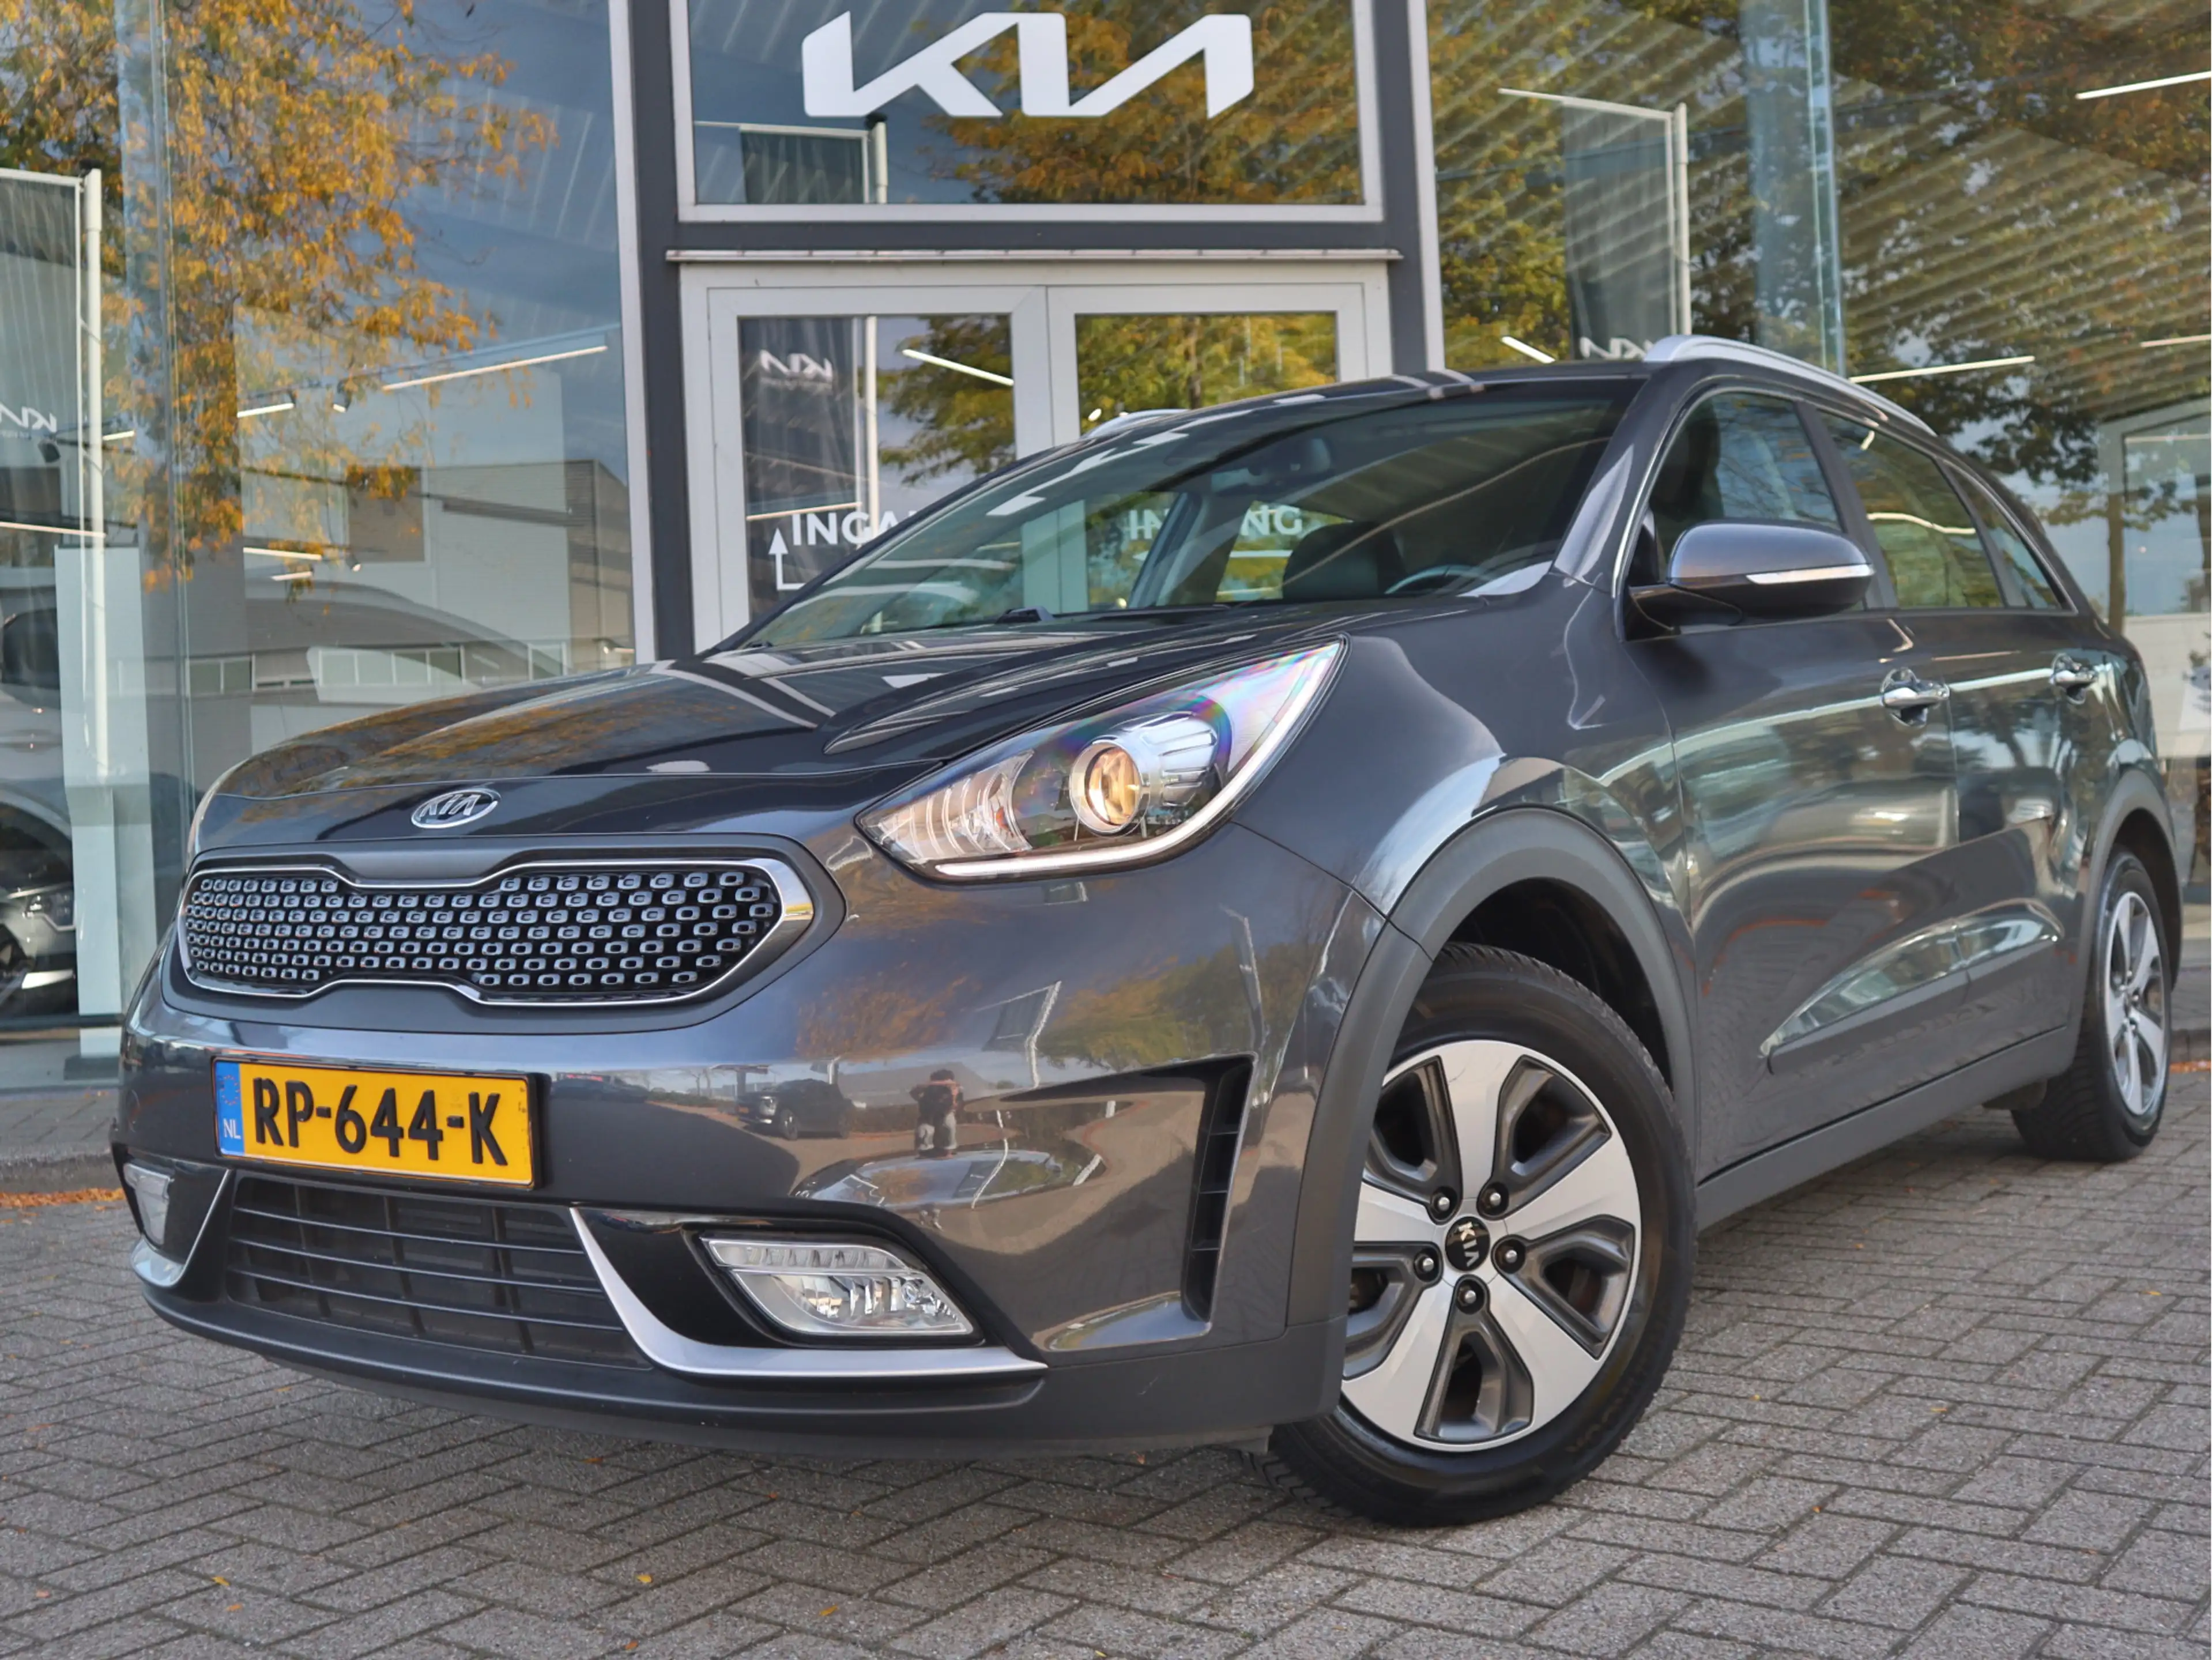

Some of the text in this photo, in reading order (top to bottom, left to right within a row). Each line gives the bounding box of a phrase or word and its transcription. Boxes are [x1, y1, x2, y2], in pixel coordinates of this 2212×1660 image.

[802, 11, 1254, 119] KIA
[792, 510, 917, 546] INGA
[419, 794, 481, 817] KIA
[223, 1118, 241, 1140] NL
[253, 1077, 508, 1166] RP-644-K
[1458, 1221, 1480, 1267] KIA
